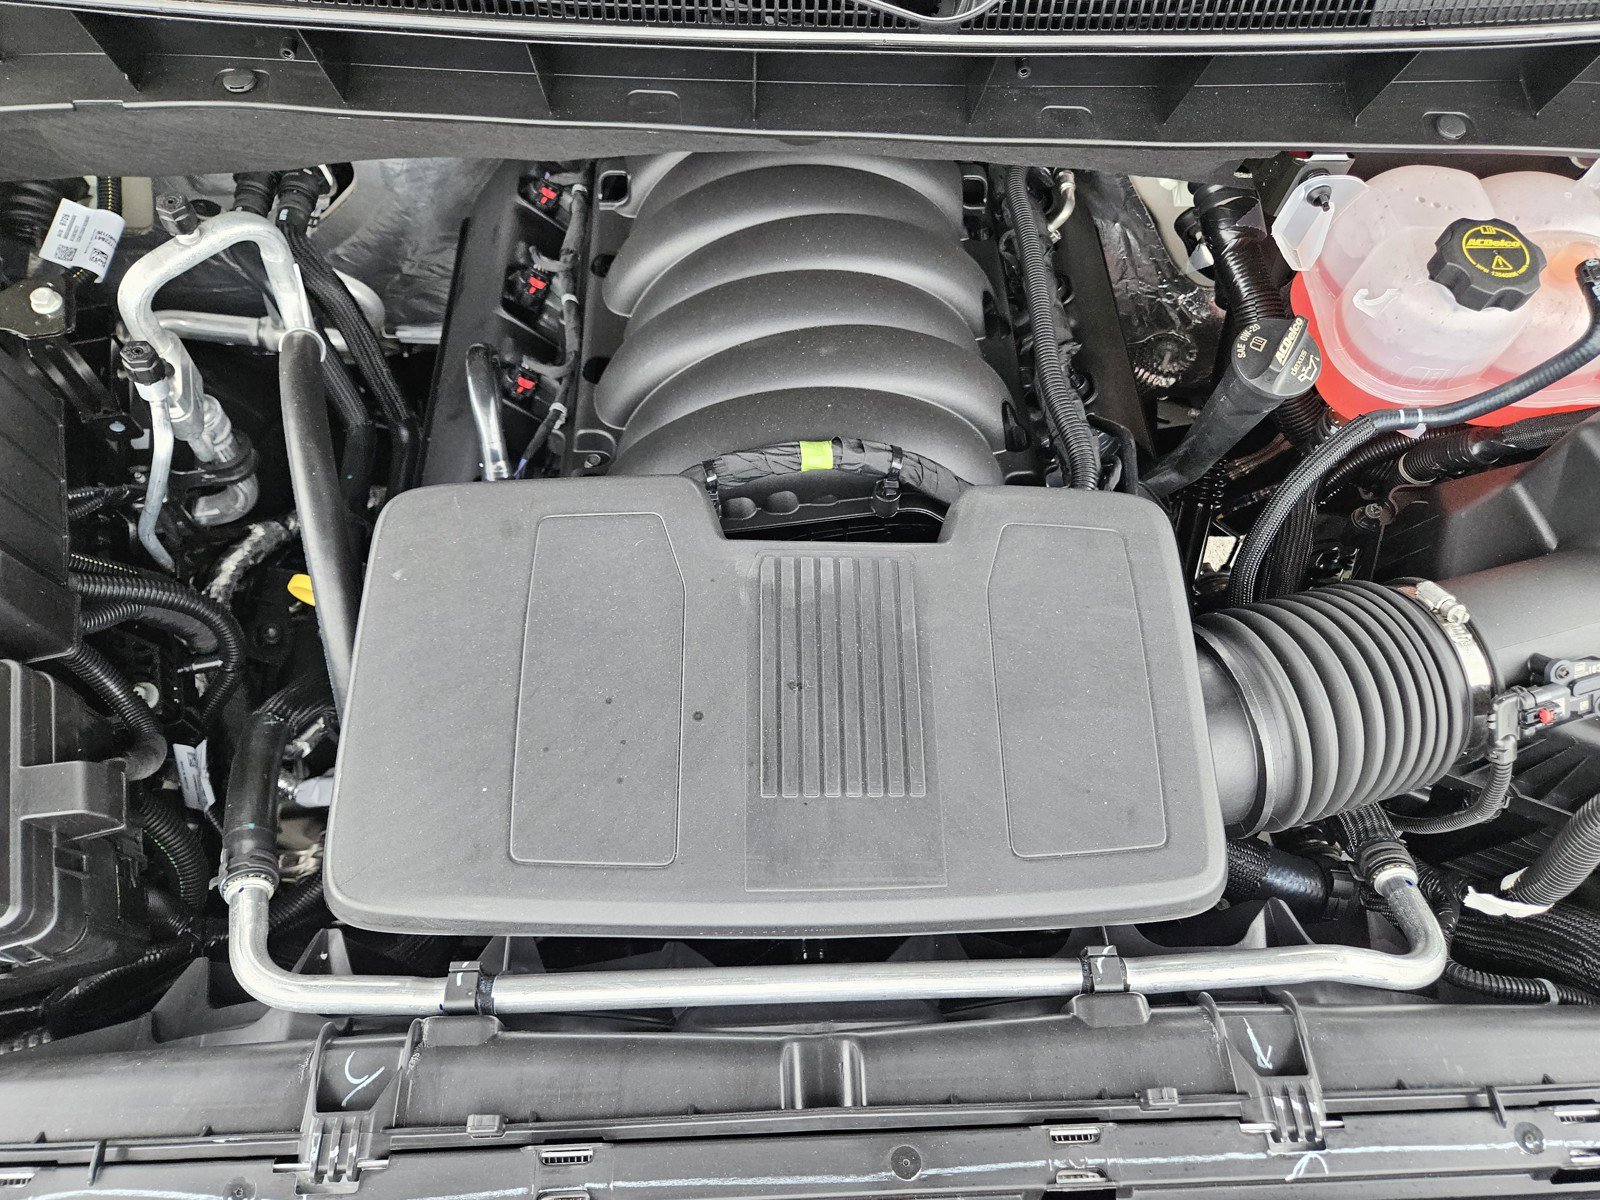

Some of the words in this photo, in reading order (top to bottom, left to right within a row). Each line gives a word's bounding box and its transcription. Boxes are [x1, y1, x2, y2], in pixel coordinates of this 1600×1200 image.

[1466, 238, 1521, 247] ACDelco
[1239, 323, 1261, 342] 0W-20
[1275, 317, 1304, 366] ACDelco
[1236, 343, 1247, 359] SAE
[1290, 349, 1308, 376] dexos
